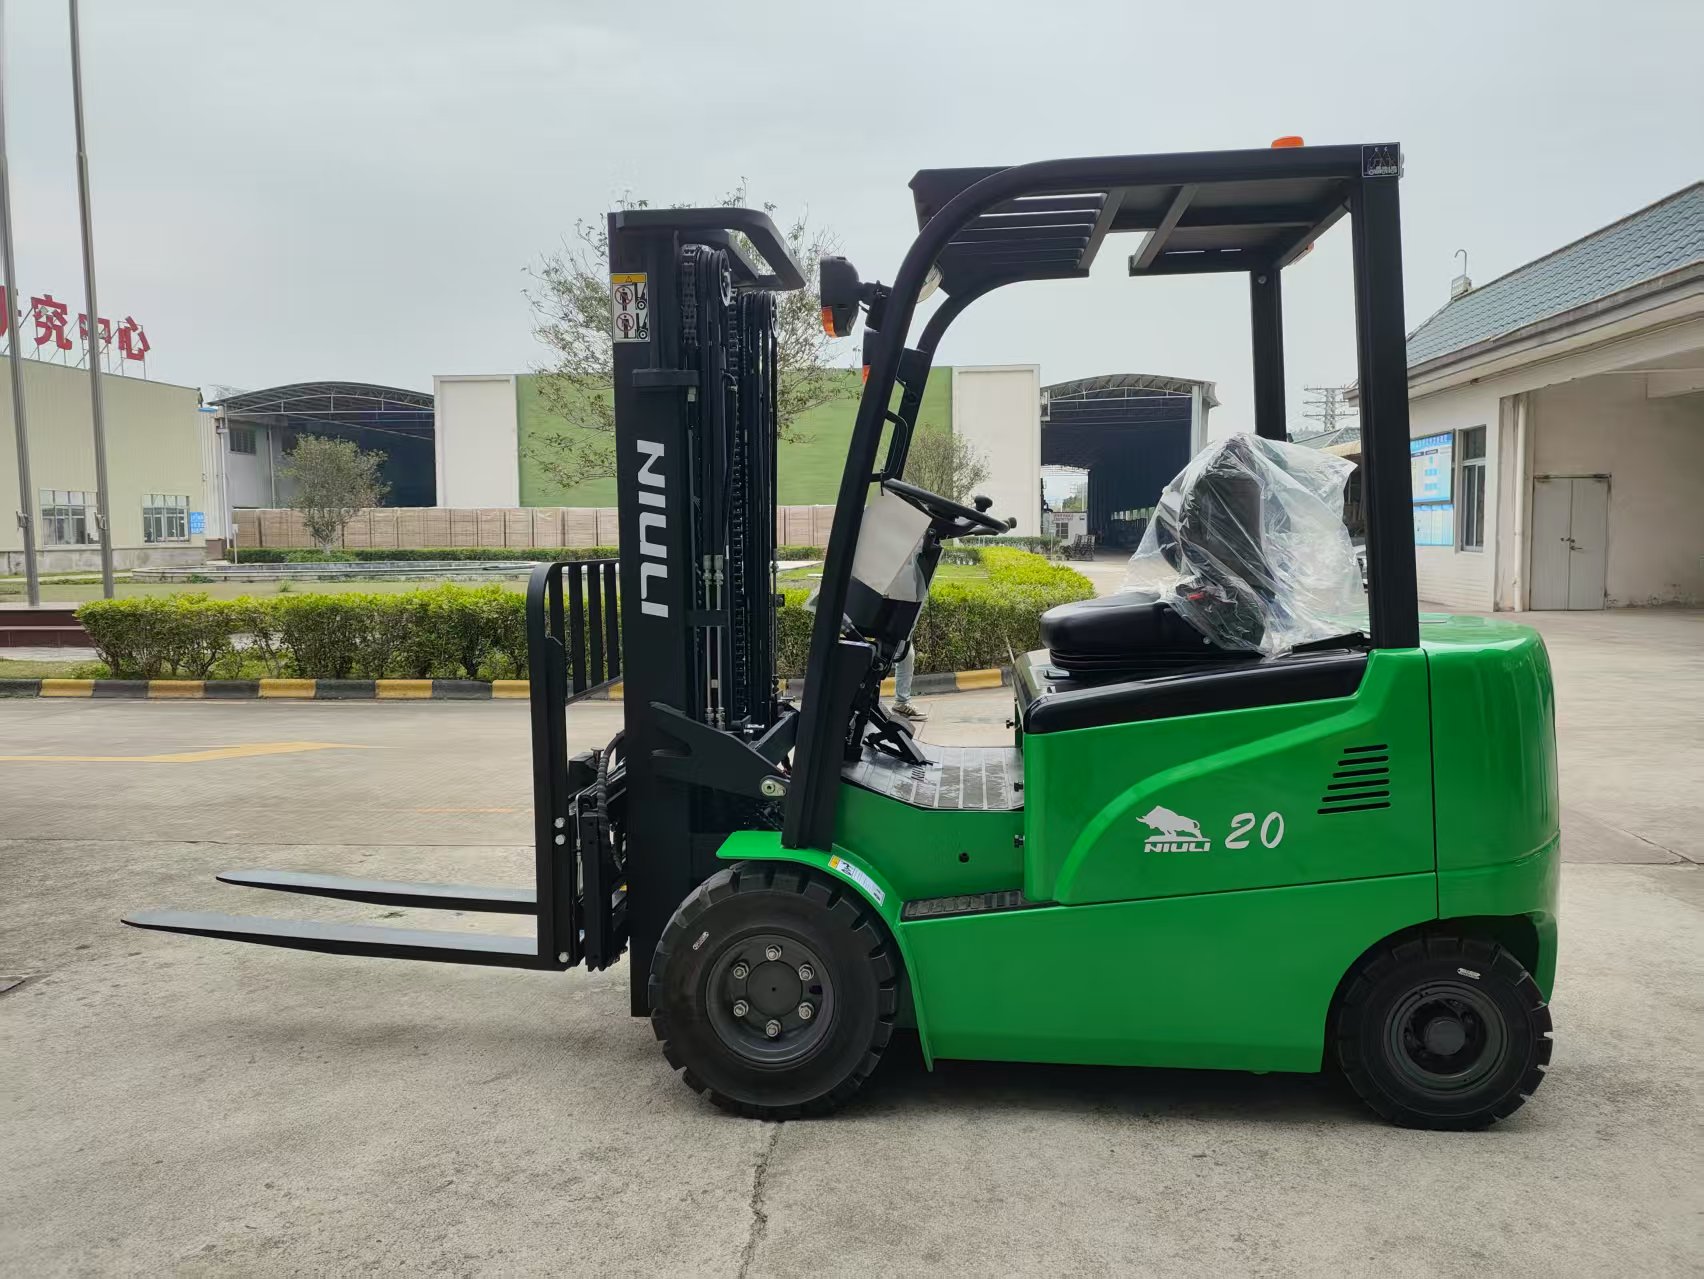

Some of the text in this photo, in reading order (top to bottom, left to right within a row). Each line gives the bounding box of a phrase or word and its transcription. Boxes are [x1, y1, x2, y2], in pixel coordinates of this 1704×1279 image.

[637, 440, 668, 618] NIULI
[1144, 842, 1211, 853] NIULI
[1225, 812, 1284, 849] 20
